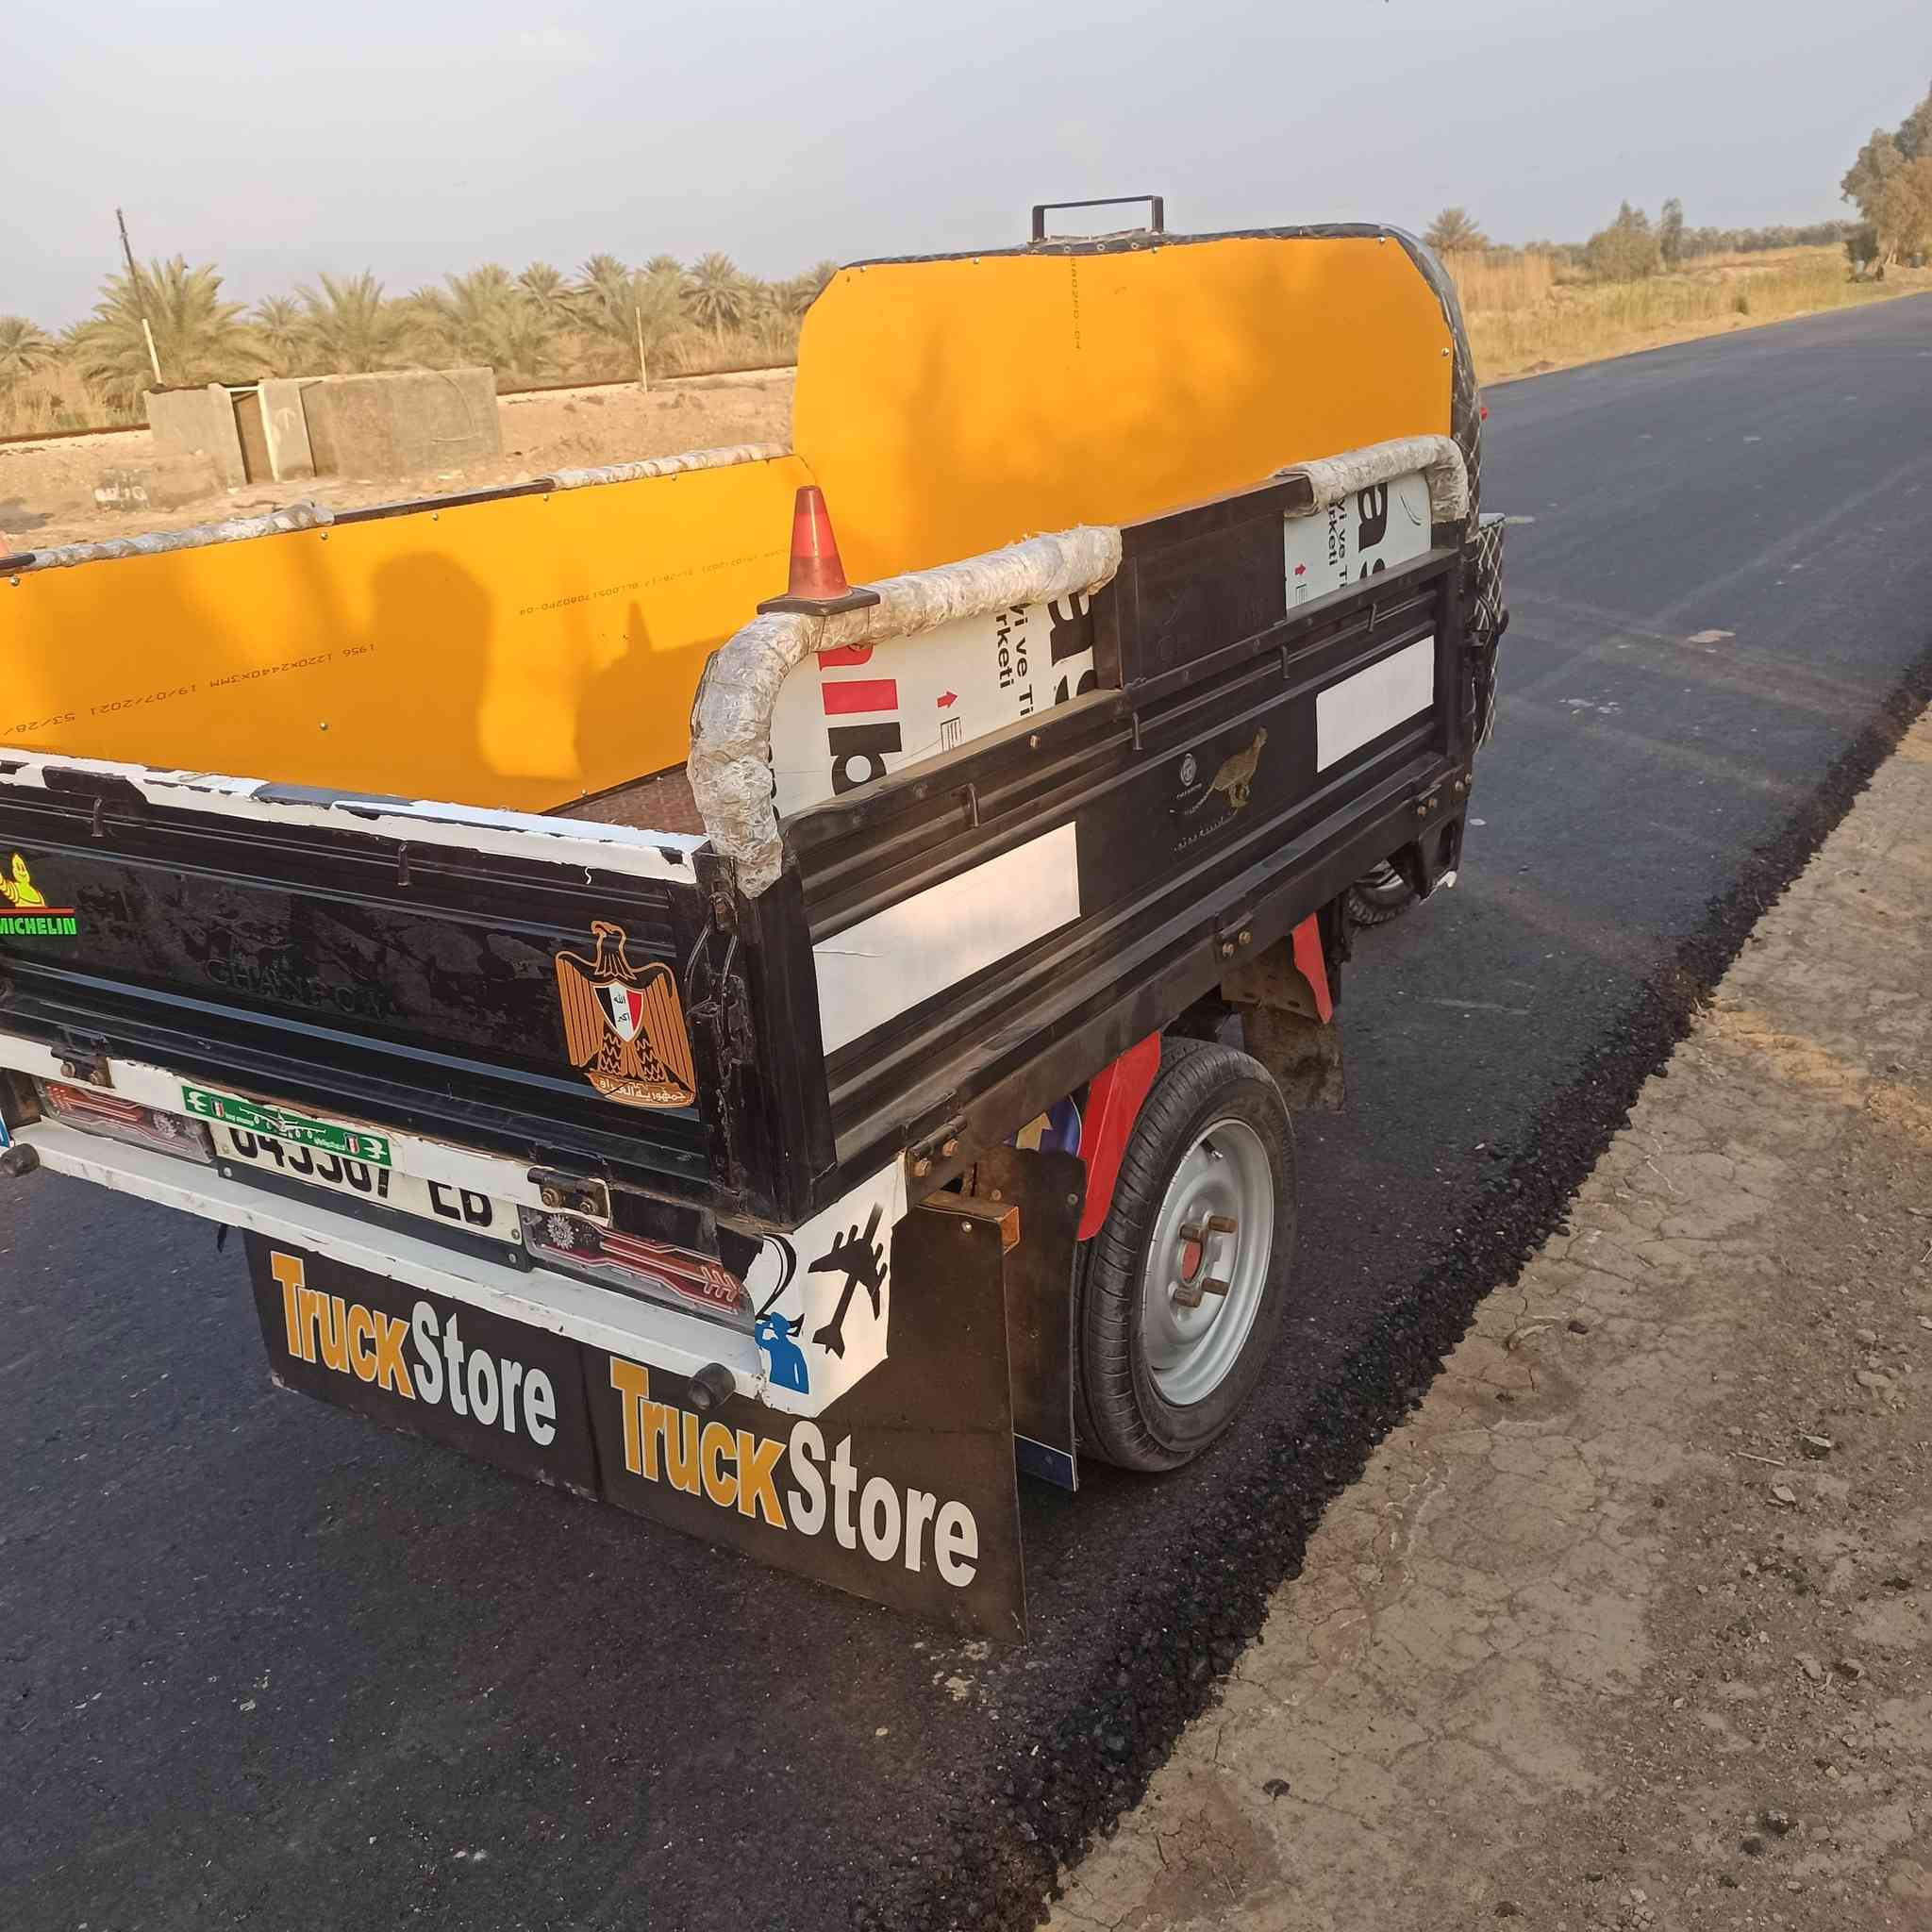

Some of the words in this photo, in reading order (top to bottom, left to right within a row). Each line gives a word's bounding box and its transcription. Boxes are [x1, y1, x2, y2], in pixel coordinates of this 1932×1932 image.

[90, 684, 196, 715] 19/07/2021
[271, 1250, 557, 1445] TruckStore
[610, 1356, 979, 1587] TruckStore
